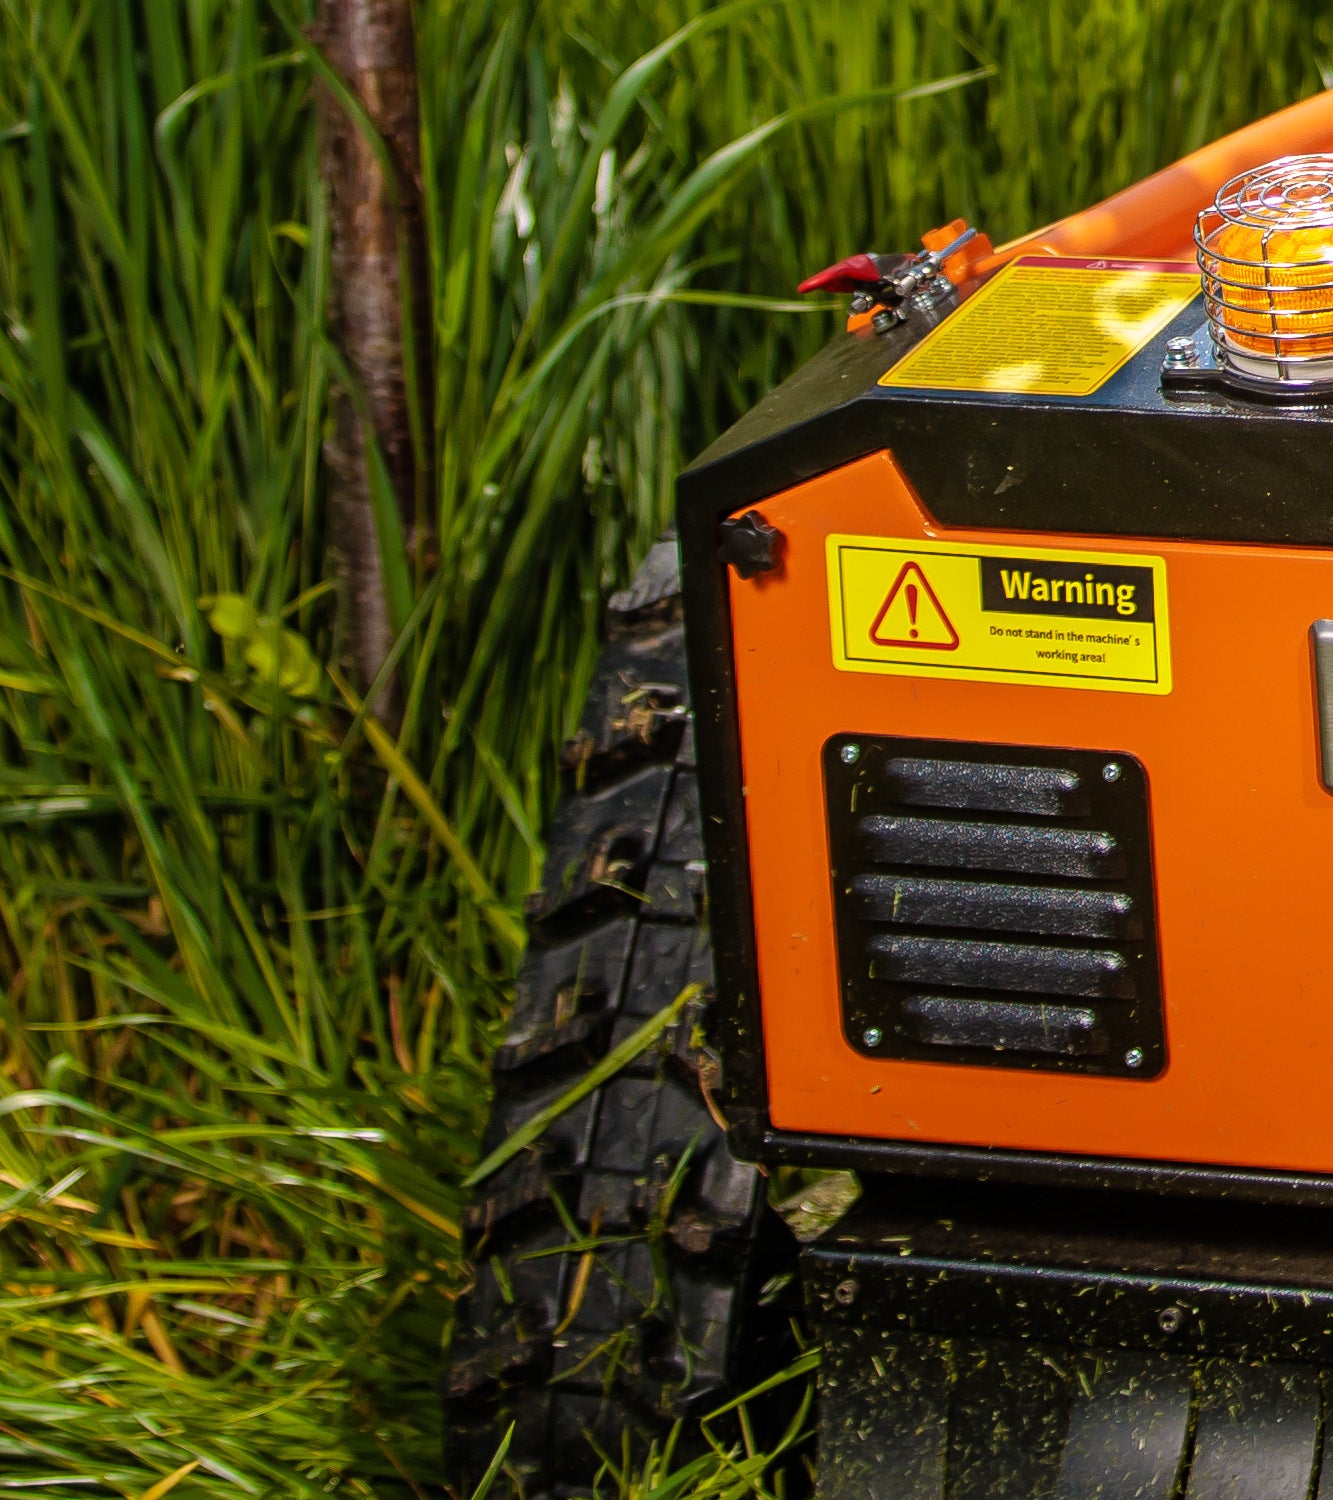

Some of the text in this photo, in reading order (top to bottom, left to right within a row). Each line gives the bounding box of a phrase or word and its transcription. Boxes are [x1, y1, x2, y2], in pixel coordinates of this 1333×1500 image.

[1000, 569, 1138, 616] Warning
[989, 625, 1004, 637] Do
[1005, 627, 1022, 638] not
[1024, 629, 1054, 640] stand
[1055, 630, 1065, 641] in
[1066, 630, 1084, 643] the
[1036, 649, 1106, 664] working area!
